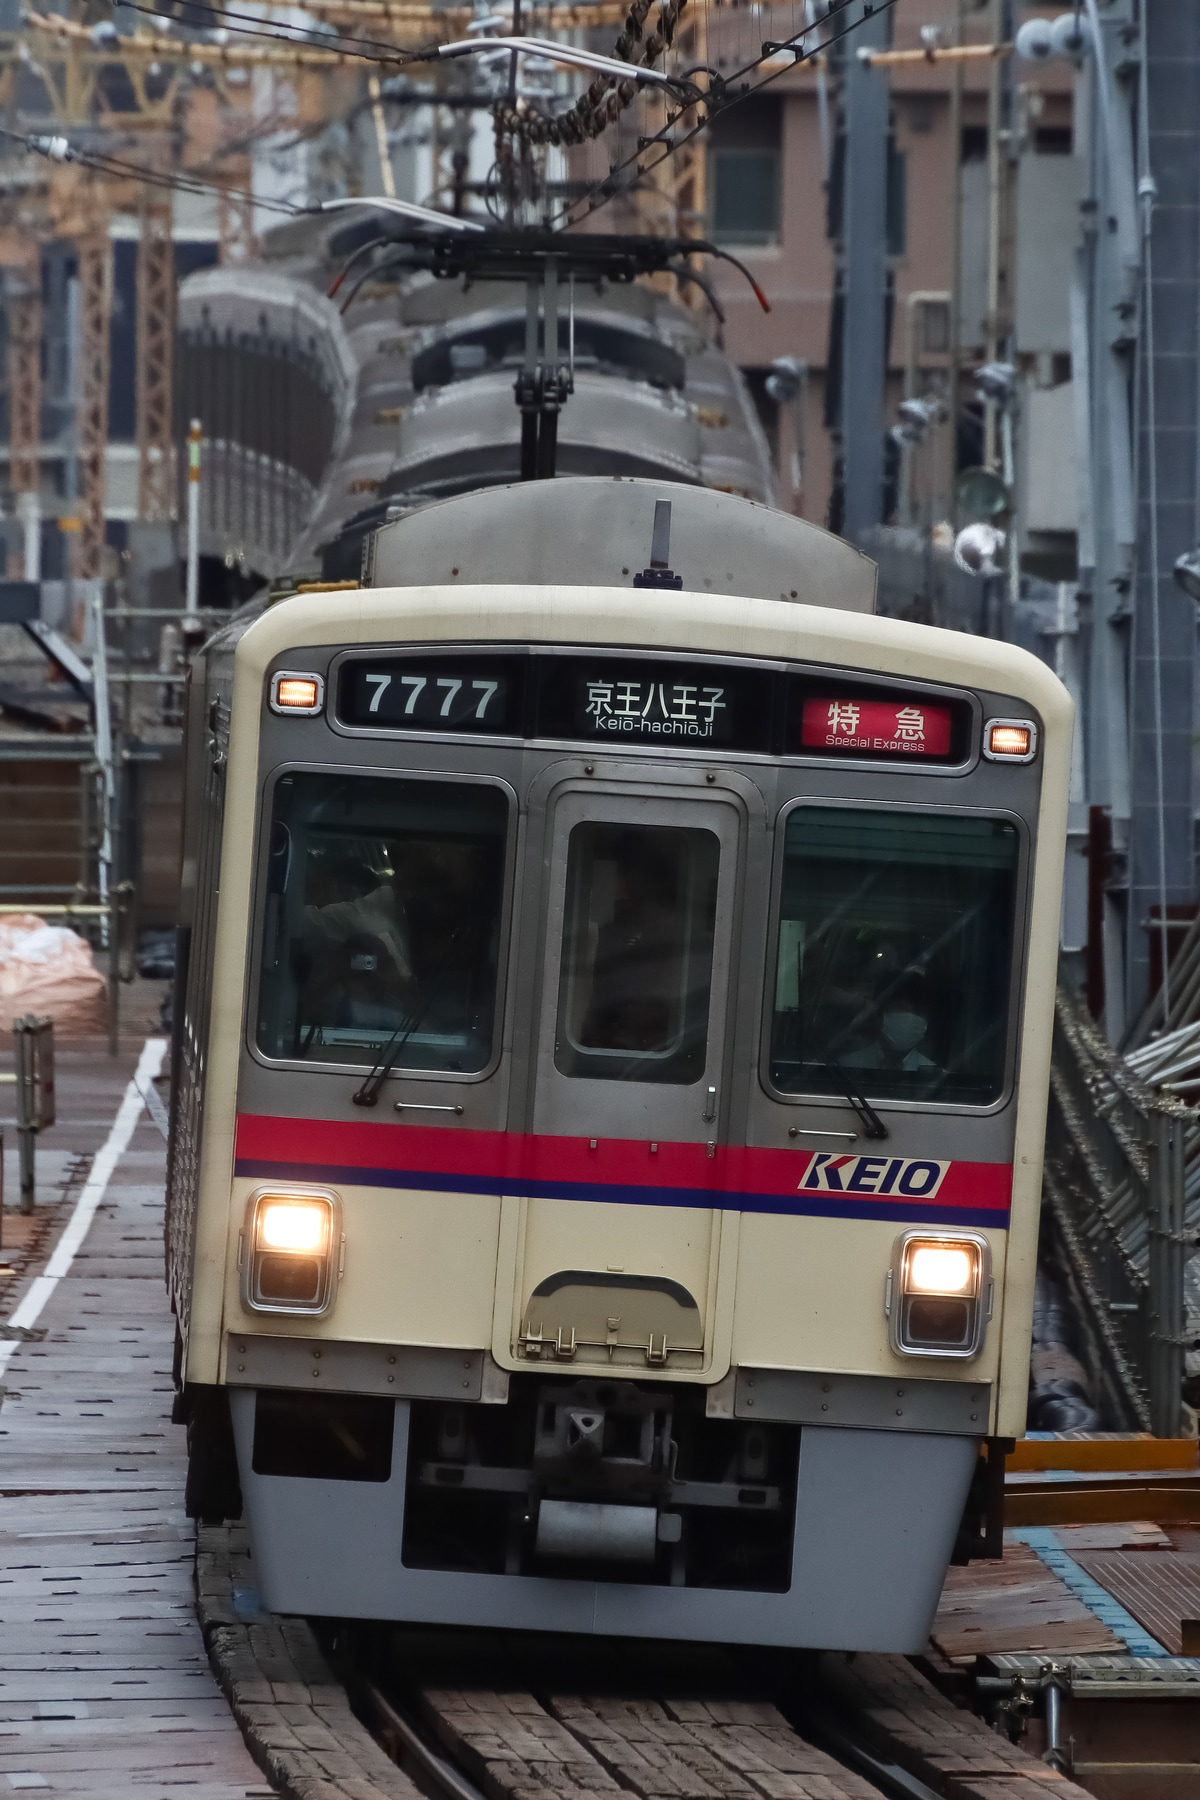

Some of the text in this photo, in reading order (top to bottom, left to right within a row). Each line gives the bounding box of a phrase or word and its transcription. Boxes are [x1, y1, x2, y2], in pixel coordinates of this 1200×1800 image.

[365, 673, 498, 719] 7777
[585, 679, 727, 723] 京王八王子
[827, 701, 926, 741] 特急
[825, 734, 925, 752] Special Express
[803, 1153, 941, 1196] KEIO
